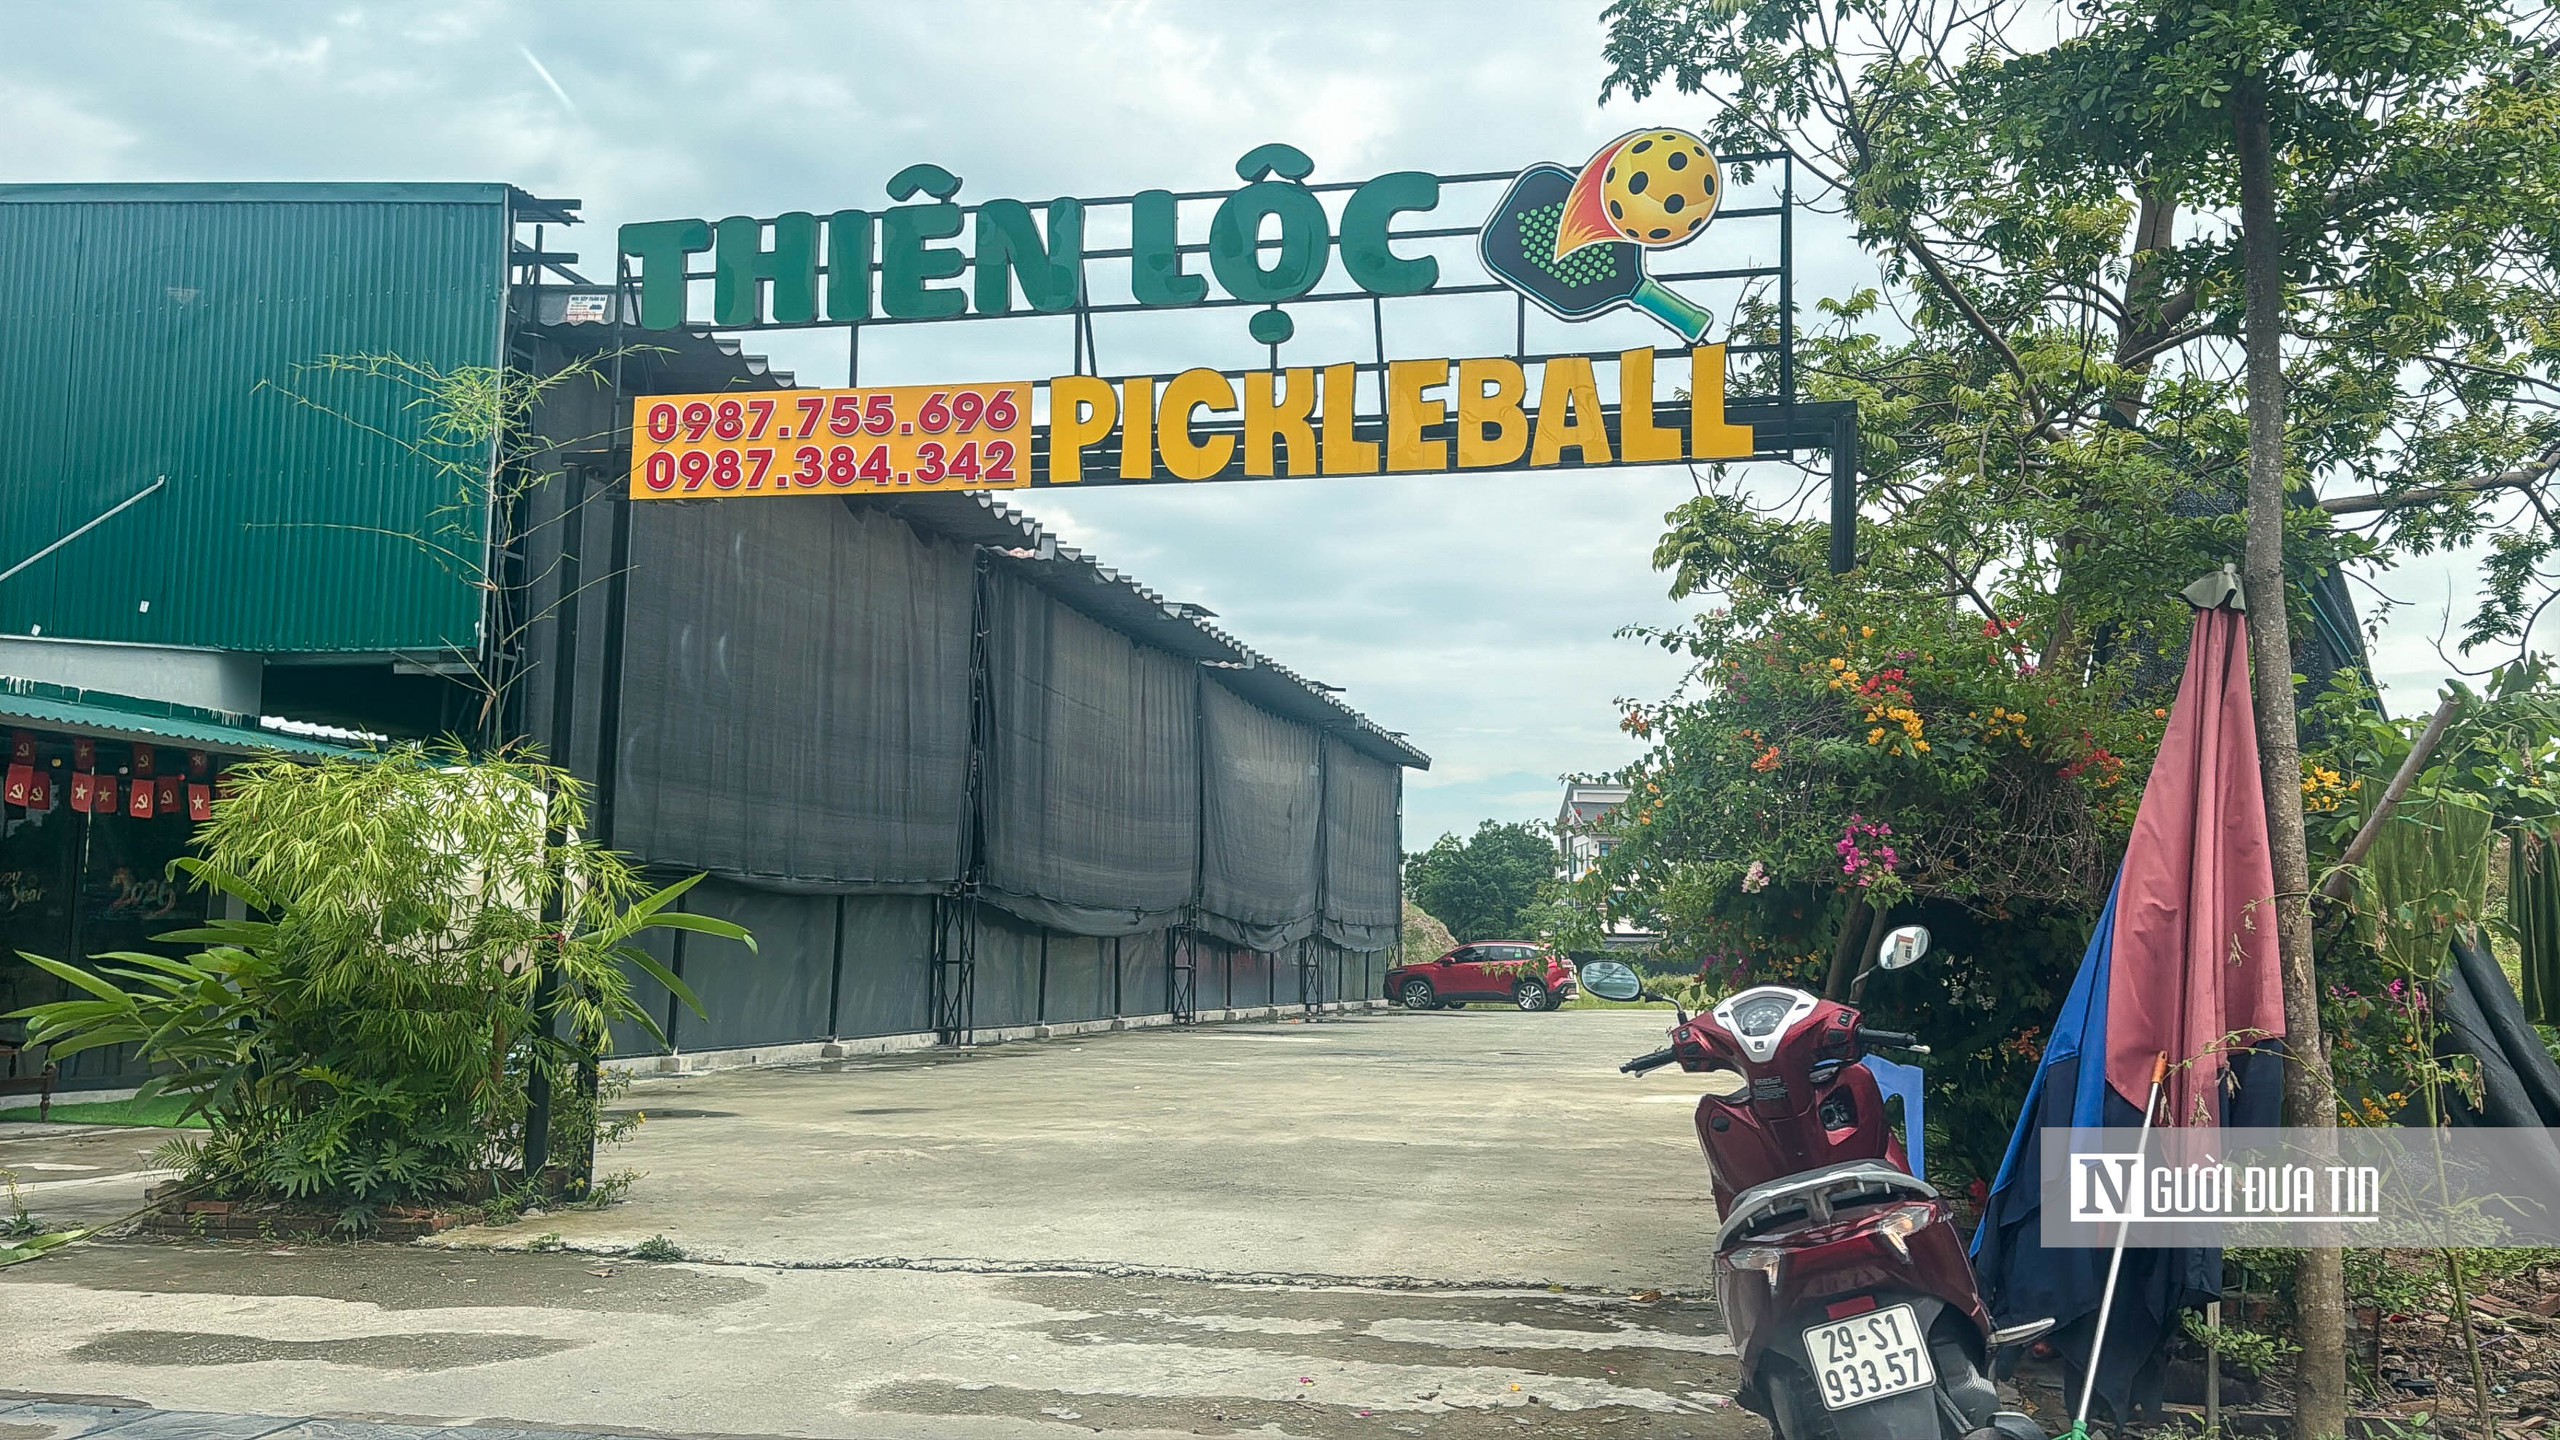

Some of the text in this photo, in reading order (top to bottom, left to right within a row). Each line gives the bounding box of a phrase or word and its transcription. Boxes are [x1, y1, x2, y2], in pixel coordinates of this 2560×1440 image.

[618, 143, 1441, 345] THIÊN LỘC
[647, 389, 1018, 443] 0987.755.696
[1049, 343, 1754, 486] PICKLEBALL
[645, 439, 1017, 492] 0987.384.342
[1821, 1313, 1903, 1364] 29-S1
[1825, 1347, 1919, 1403] 933.57
